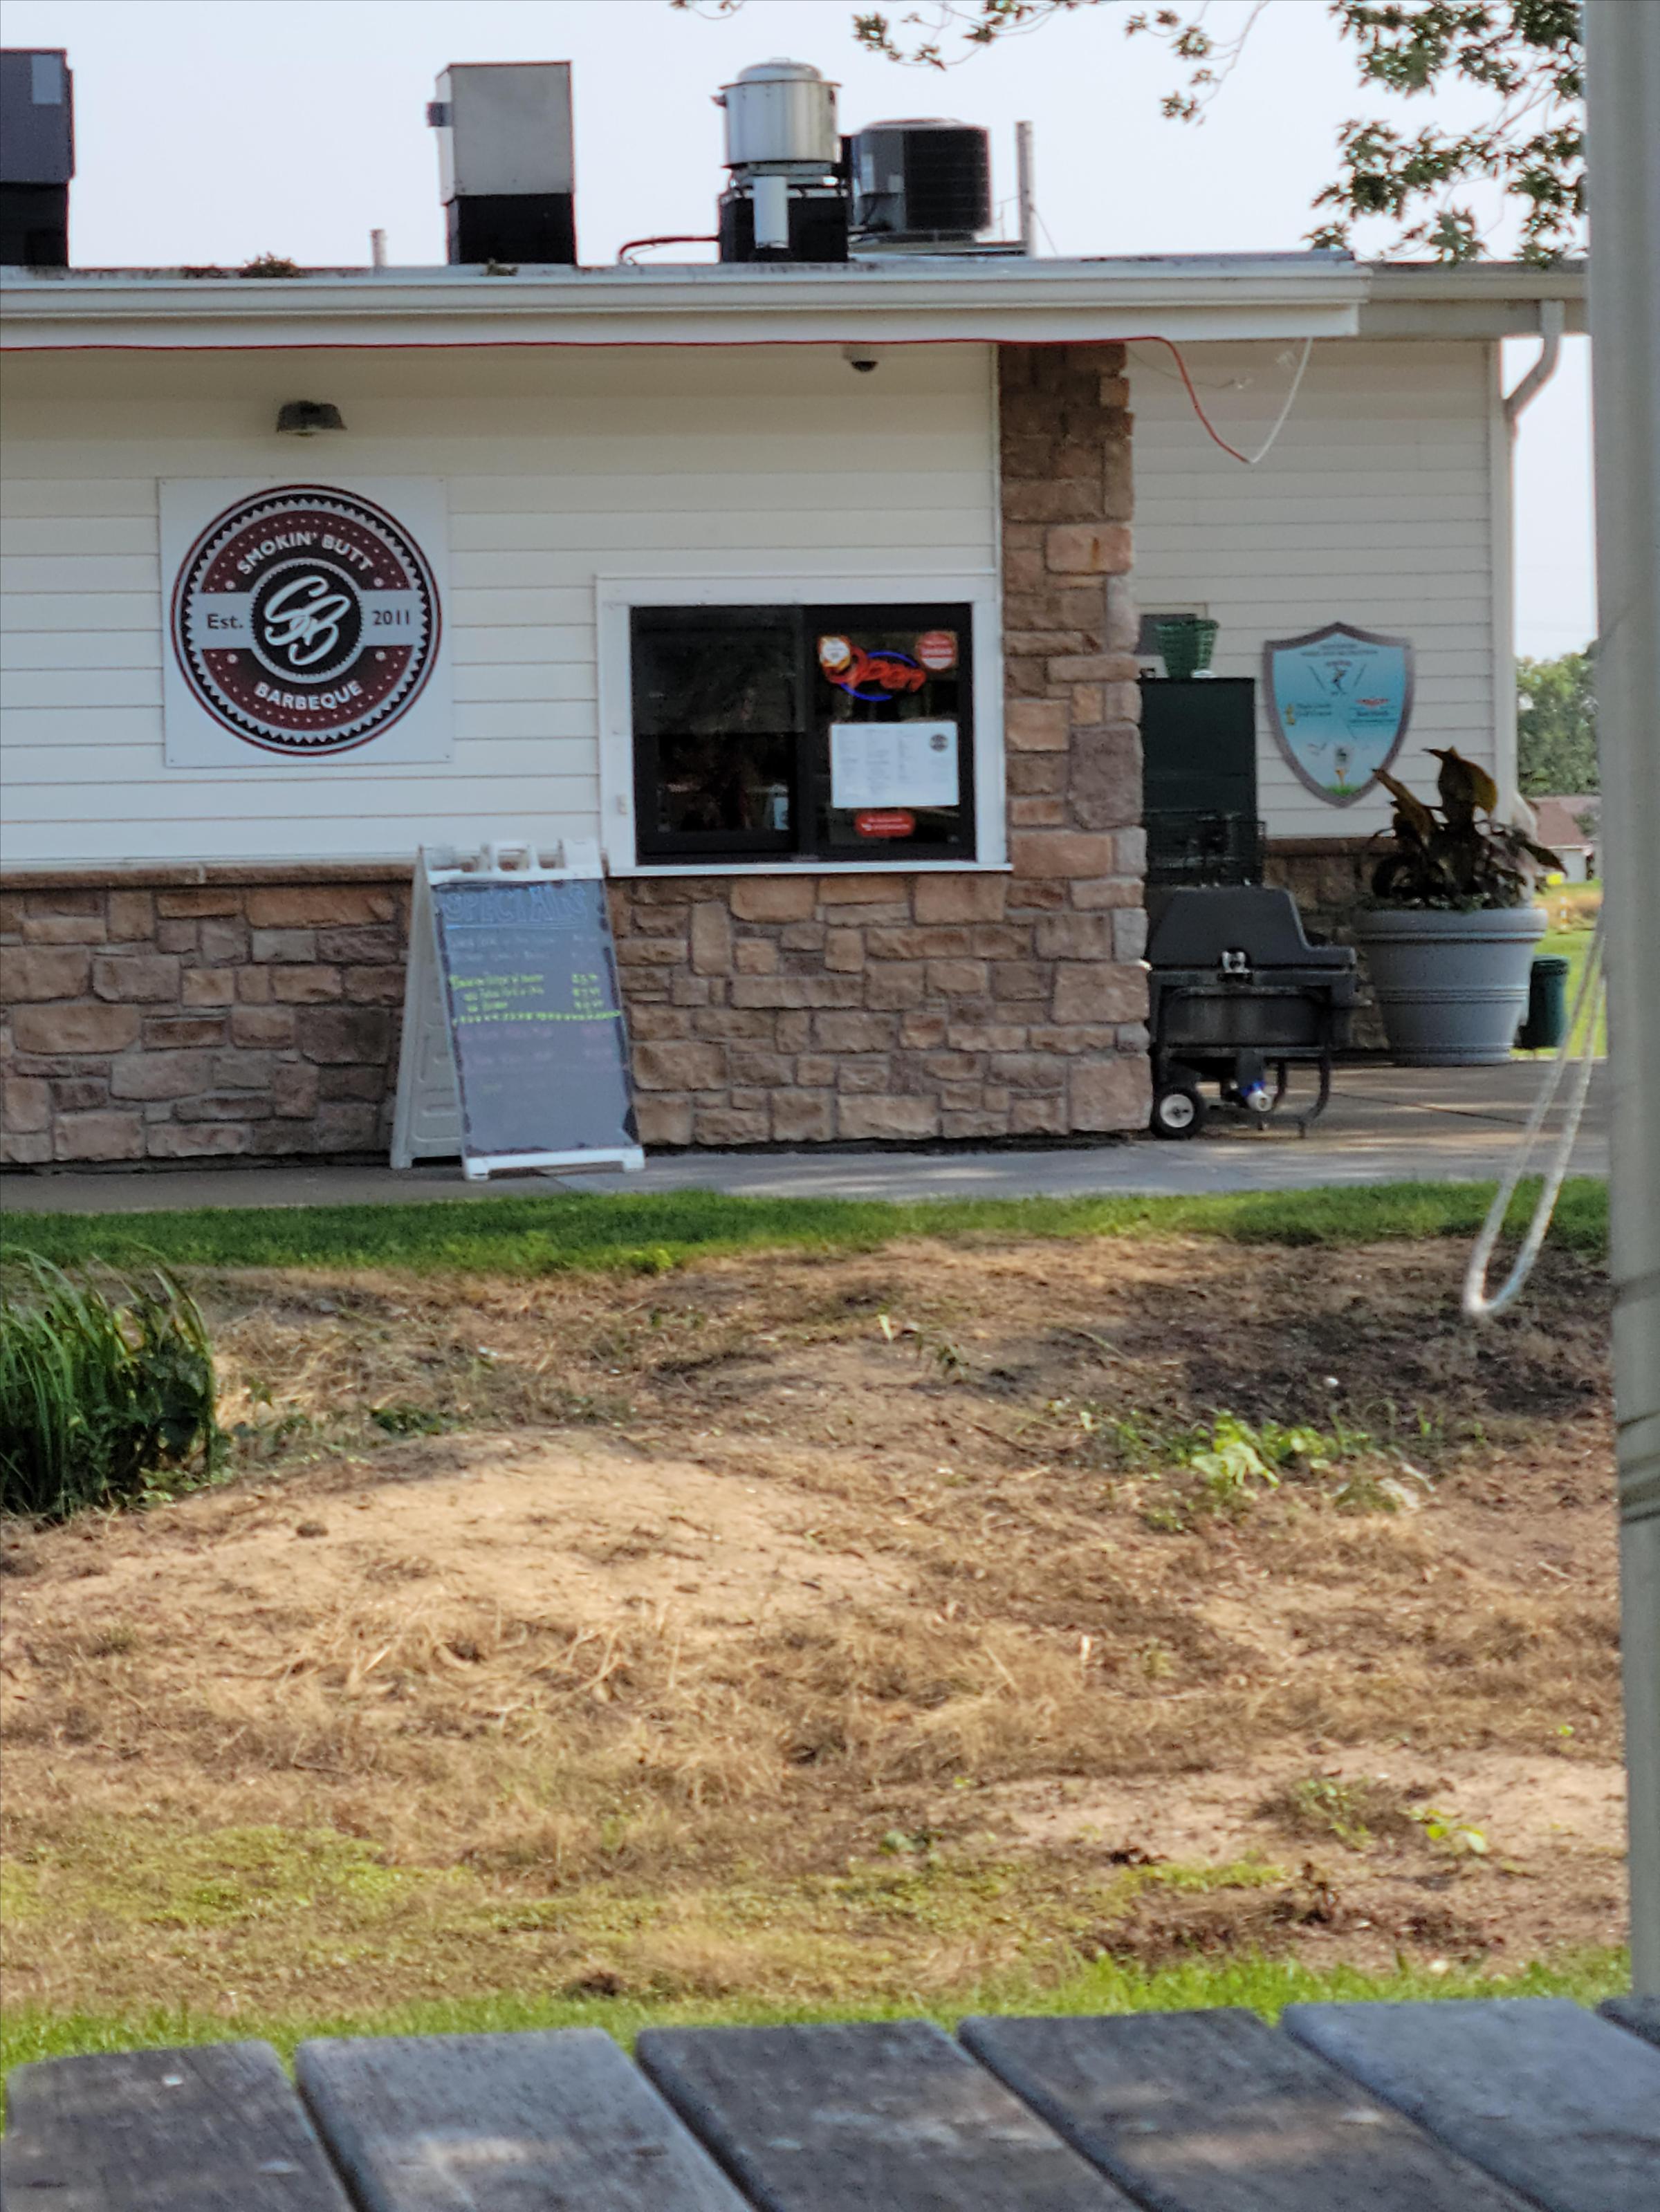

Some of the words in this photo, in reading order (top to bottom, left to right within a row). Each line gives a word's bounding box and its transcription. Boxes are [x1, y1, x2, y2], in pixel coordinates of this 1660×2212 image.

[237, 531, 317, 575] SMOKIN'
[322, 534, 374, 570] BUTT
[208, 613, 243, 629] Est.
[372, 611, 409, 626] 2011
[255, 680, 363, 710] BARBEQUE
